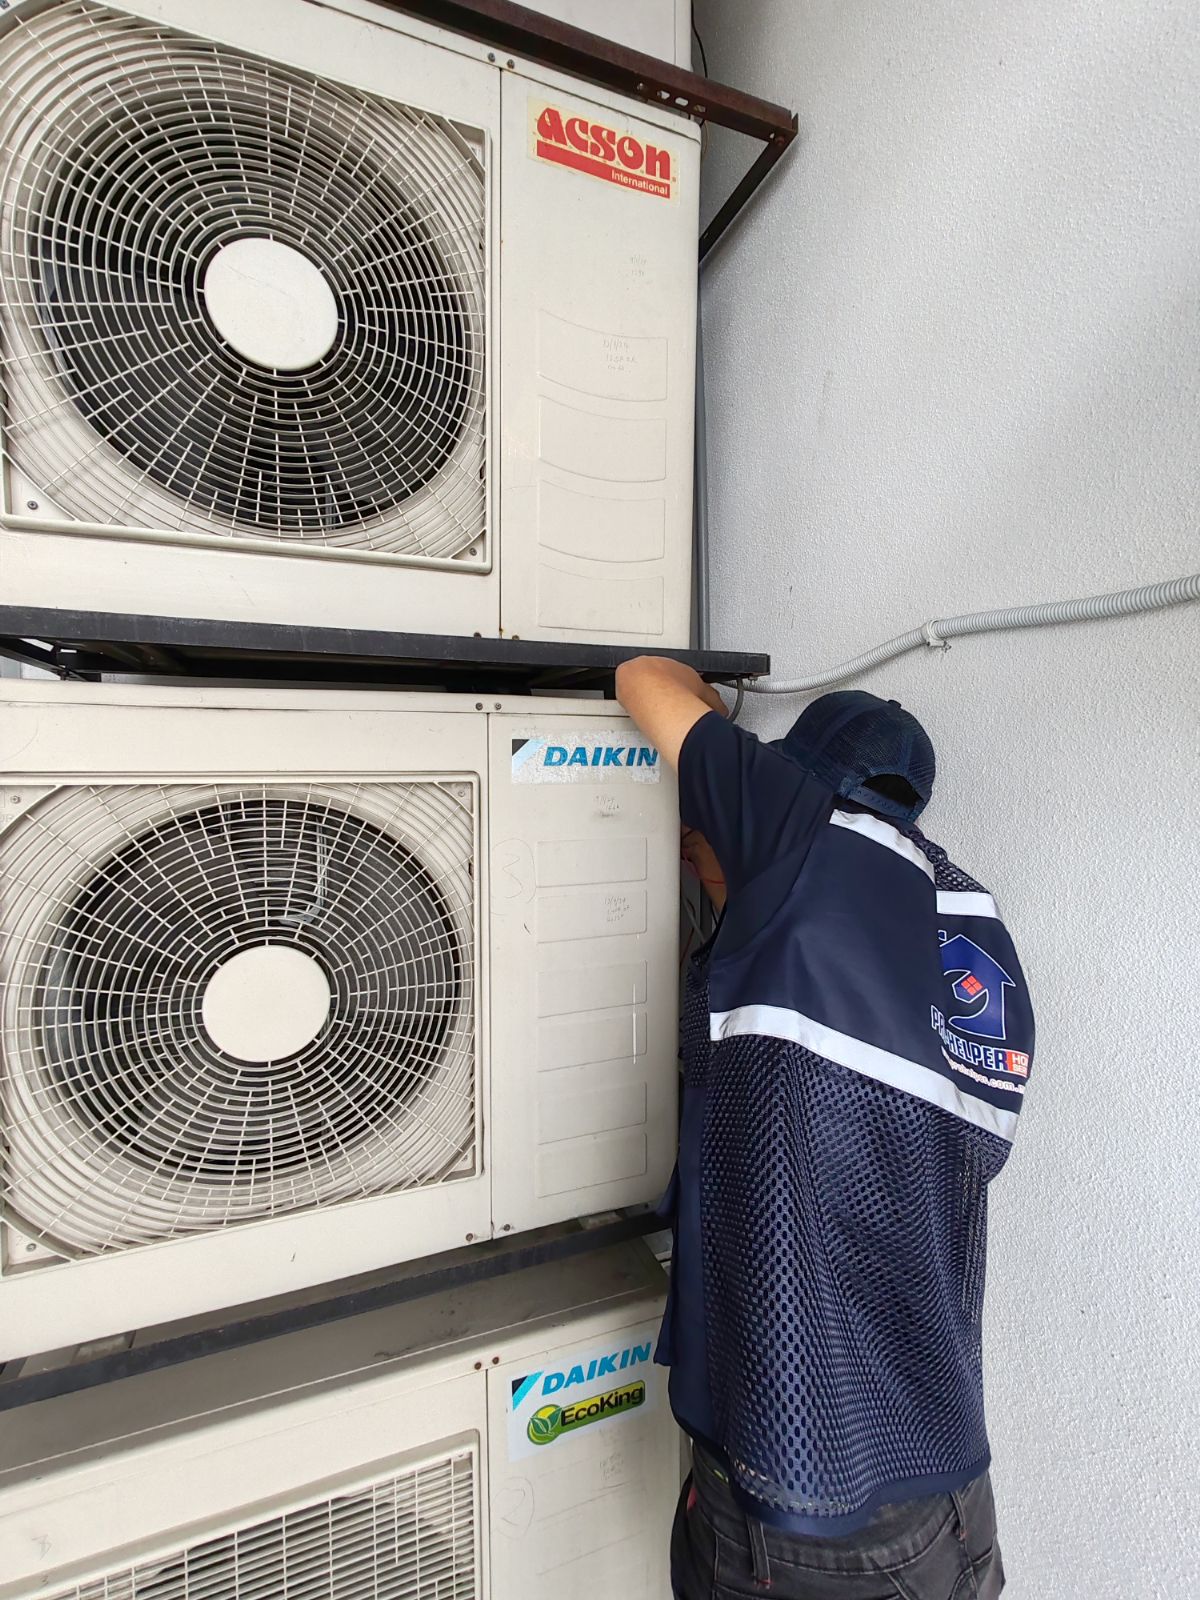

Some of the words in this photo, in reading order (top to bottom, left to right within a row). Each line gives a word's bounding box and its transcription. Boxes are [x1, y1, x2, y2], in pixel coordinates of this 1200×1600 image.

[611, 169, 668, 195] International
[543, 746, 658, 767] DAIKIN
[542, 1342, 651, 1396] DAIKIN
[561, 1386, 643, 1427] EcoKing
